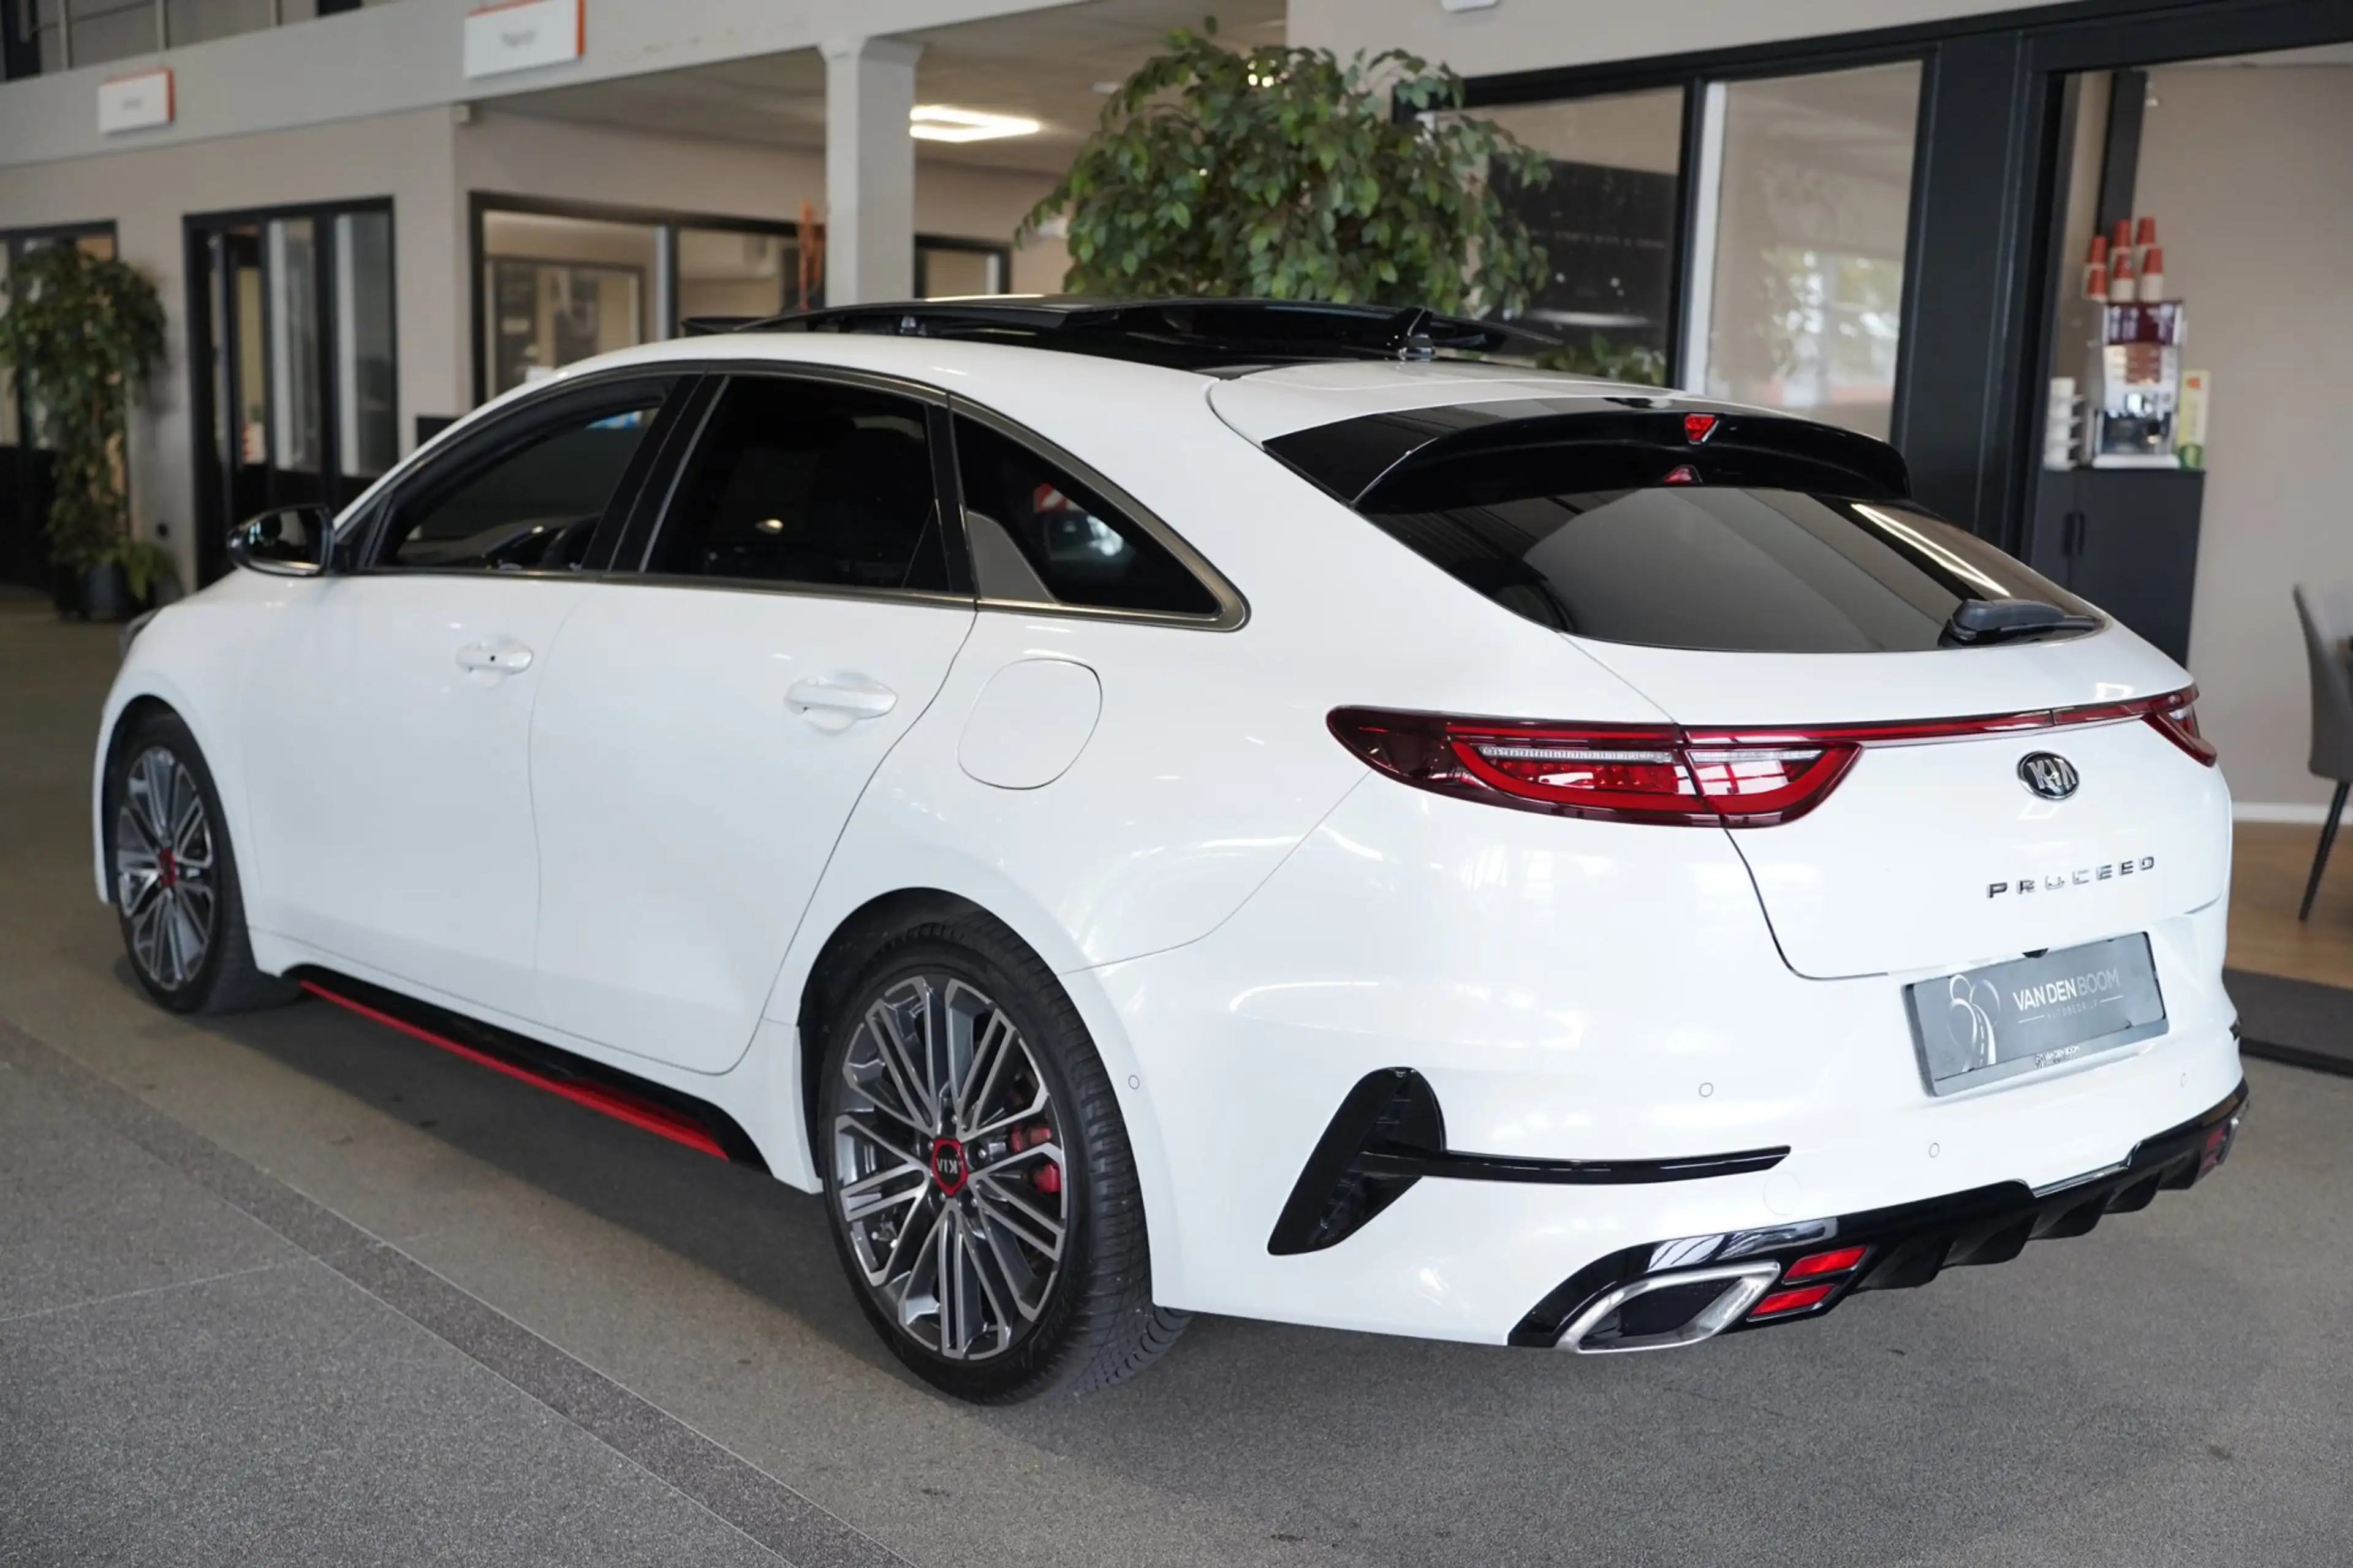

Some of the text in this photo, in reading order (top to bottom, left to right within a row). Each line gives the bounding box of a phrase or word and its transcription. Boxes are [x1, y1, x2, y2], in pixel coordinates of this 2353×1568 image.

[2026, 757, 2077, 793] KIA
[1987, 856, 2154, 898] PROCEED
[2012, 967, 2121, 1012] VAN DEN BOOM
[936, 1158, 958, 1174] KIA
